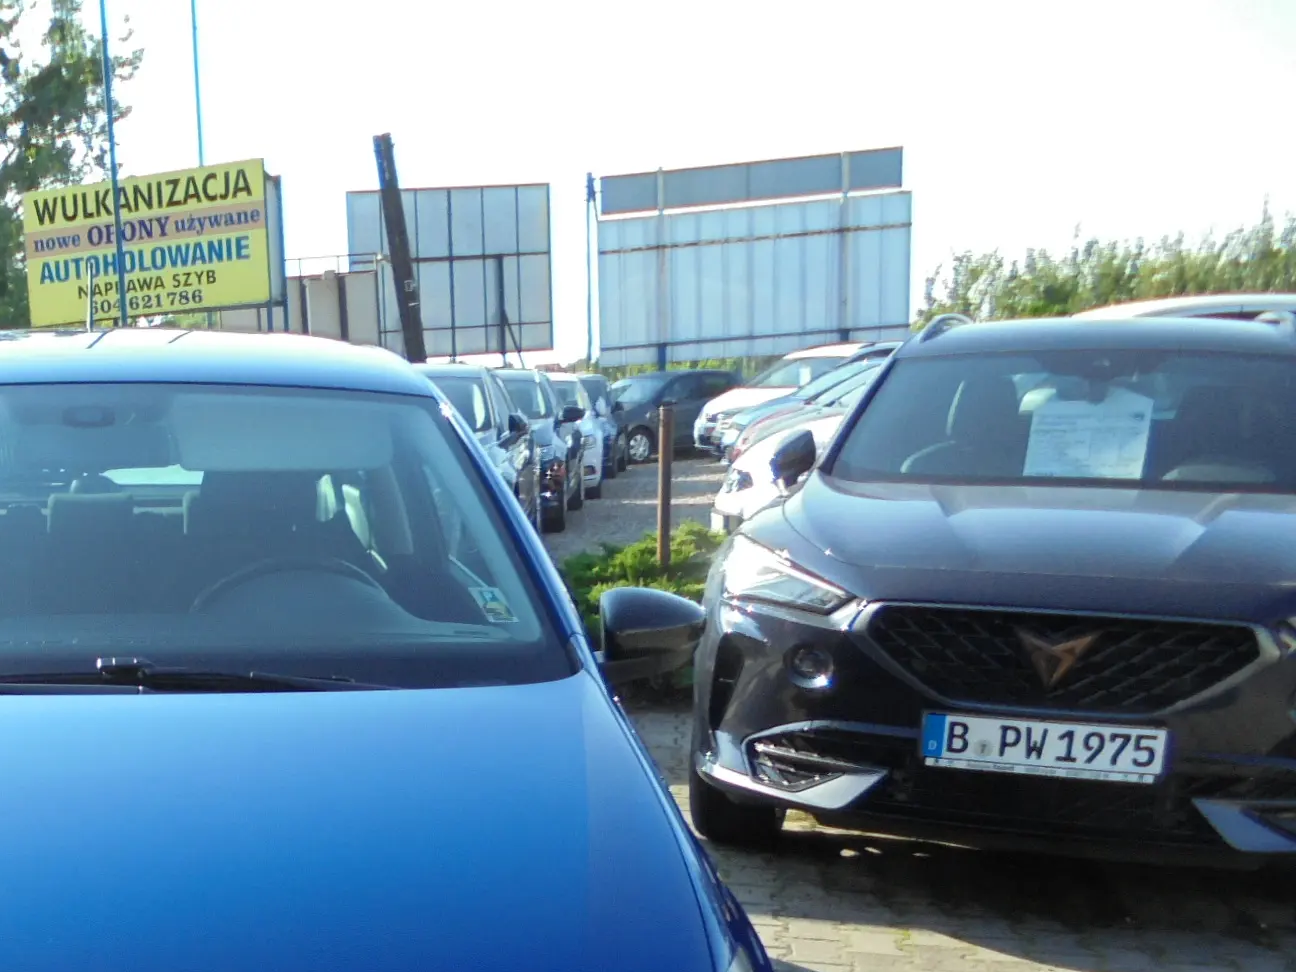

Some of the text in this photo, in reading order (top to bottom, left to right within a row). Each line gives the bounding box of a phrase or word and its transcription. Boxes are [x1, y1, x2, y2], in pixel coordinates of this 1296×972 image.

[33, 168, 253, 226] WULKANIZACJA
[33, 233, 81, 253] nowe
[174, 209, 260, 236] używane
[39, 236, 251, 285] AUTOHOLOWANIE
[172, 269, 217, 288] SZYB
[128, 293, 163, 311] 621
[169, 288, 203, 306] 786
[946, 721, 1158, 768] B PW 1975
